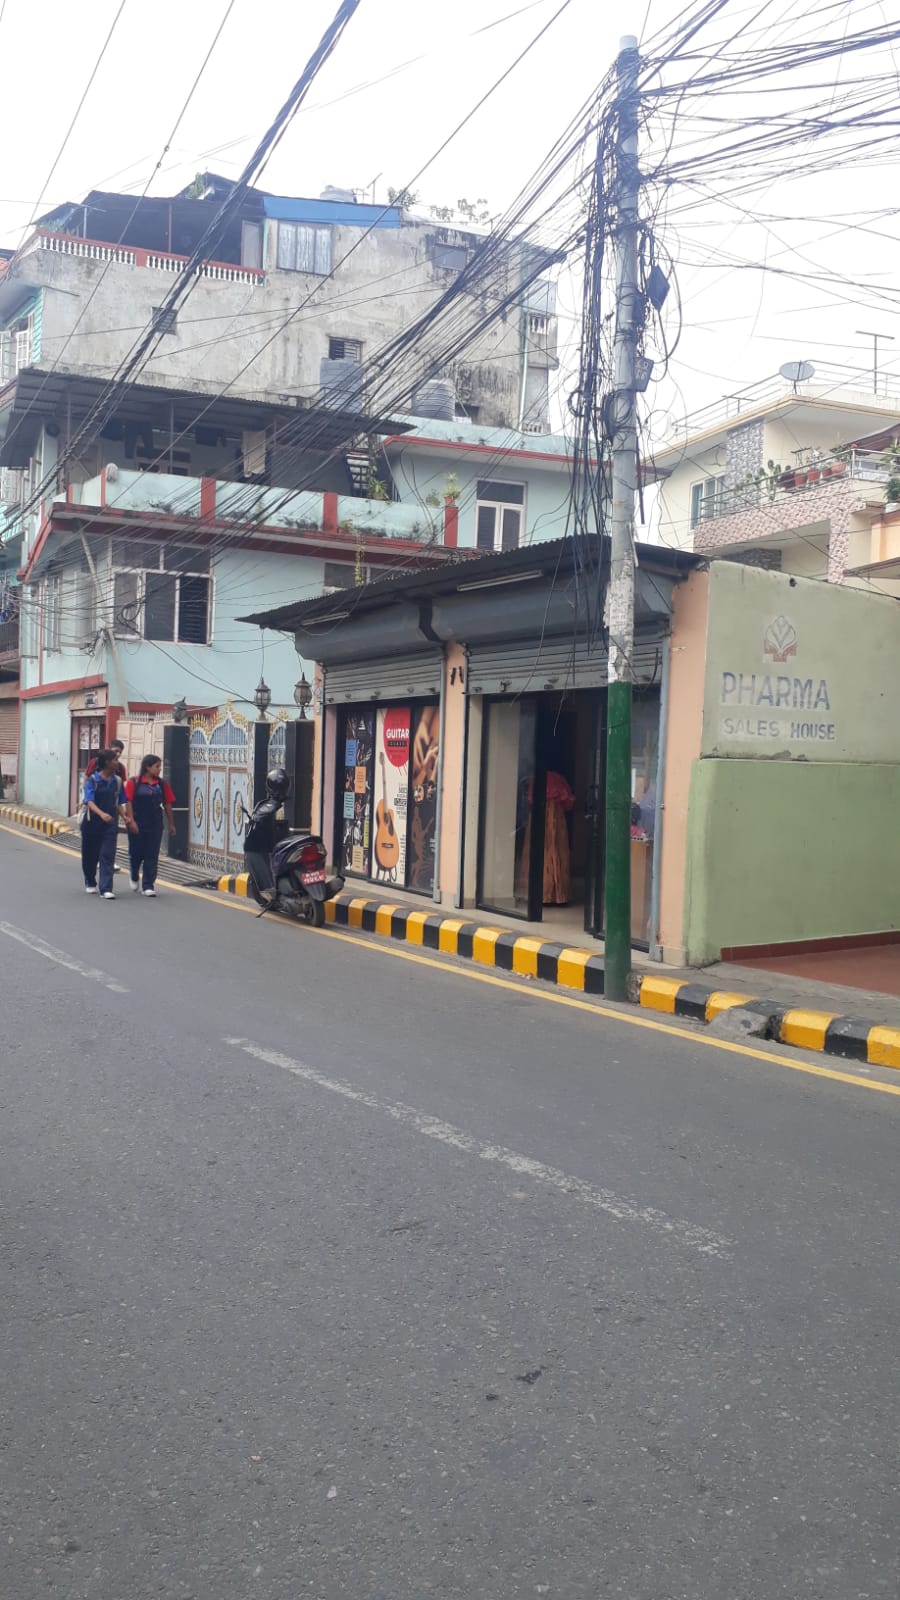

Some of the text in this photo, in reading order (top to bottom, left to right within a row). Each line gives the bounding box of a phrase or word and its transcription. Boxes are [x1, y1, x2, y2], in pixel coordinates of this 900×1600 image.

[721, 671, 830, 710] PHARMA
[386, 728, 410, 739] GUITAR
[723, 718, 835, 740] SALES HOUSE
